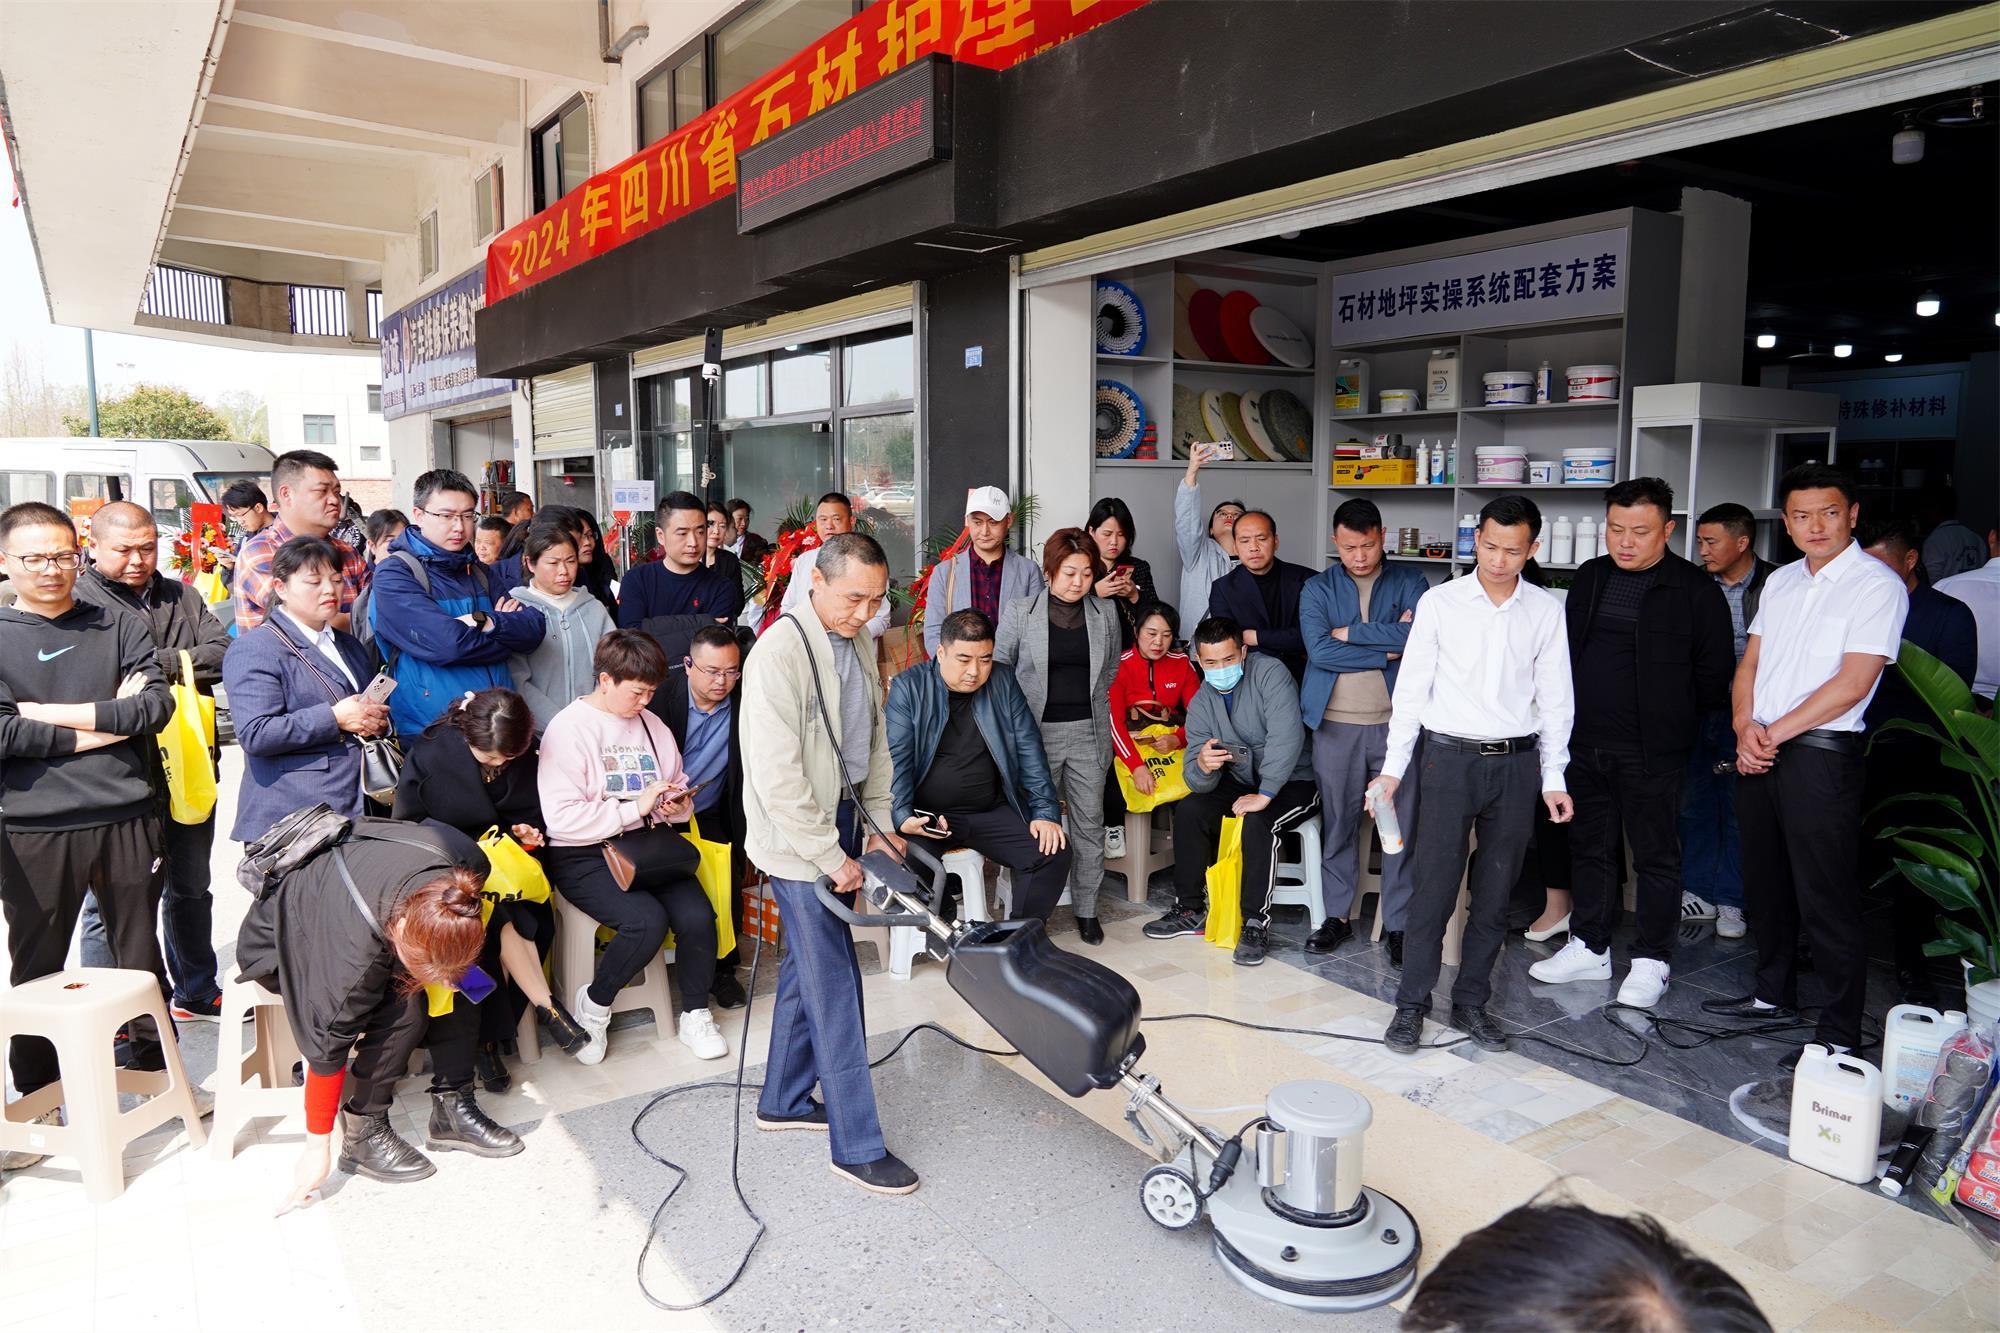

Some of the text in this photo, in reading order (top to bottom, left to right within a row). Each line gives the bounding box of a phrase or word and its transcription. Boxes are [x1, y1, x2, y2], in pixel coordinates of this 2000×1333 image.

[1338, 253, 1618, 323] 石材地坪实操系统配套方案
[1839, 395, 1947, 420] 特殊修补材料
[1812, 1100, 1852, 1122] Brimar
